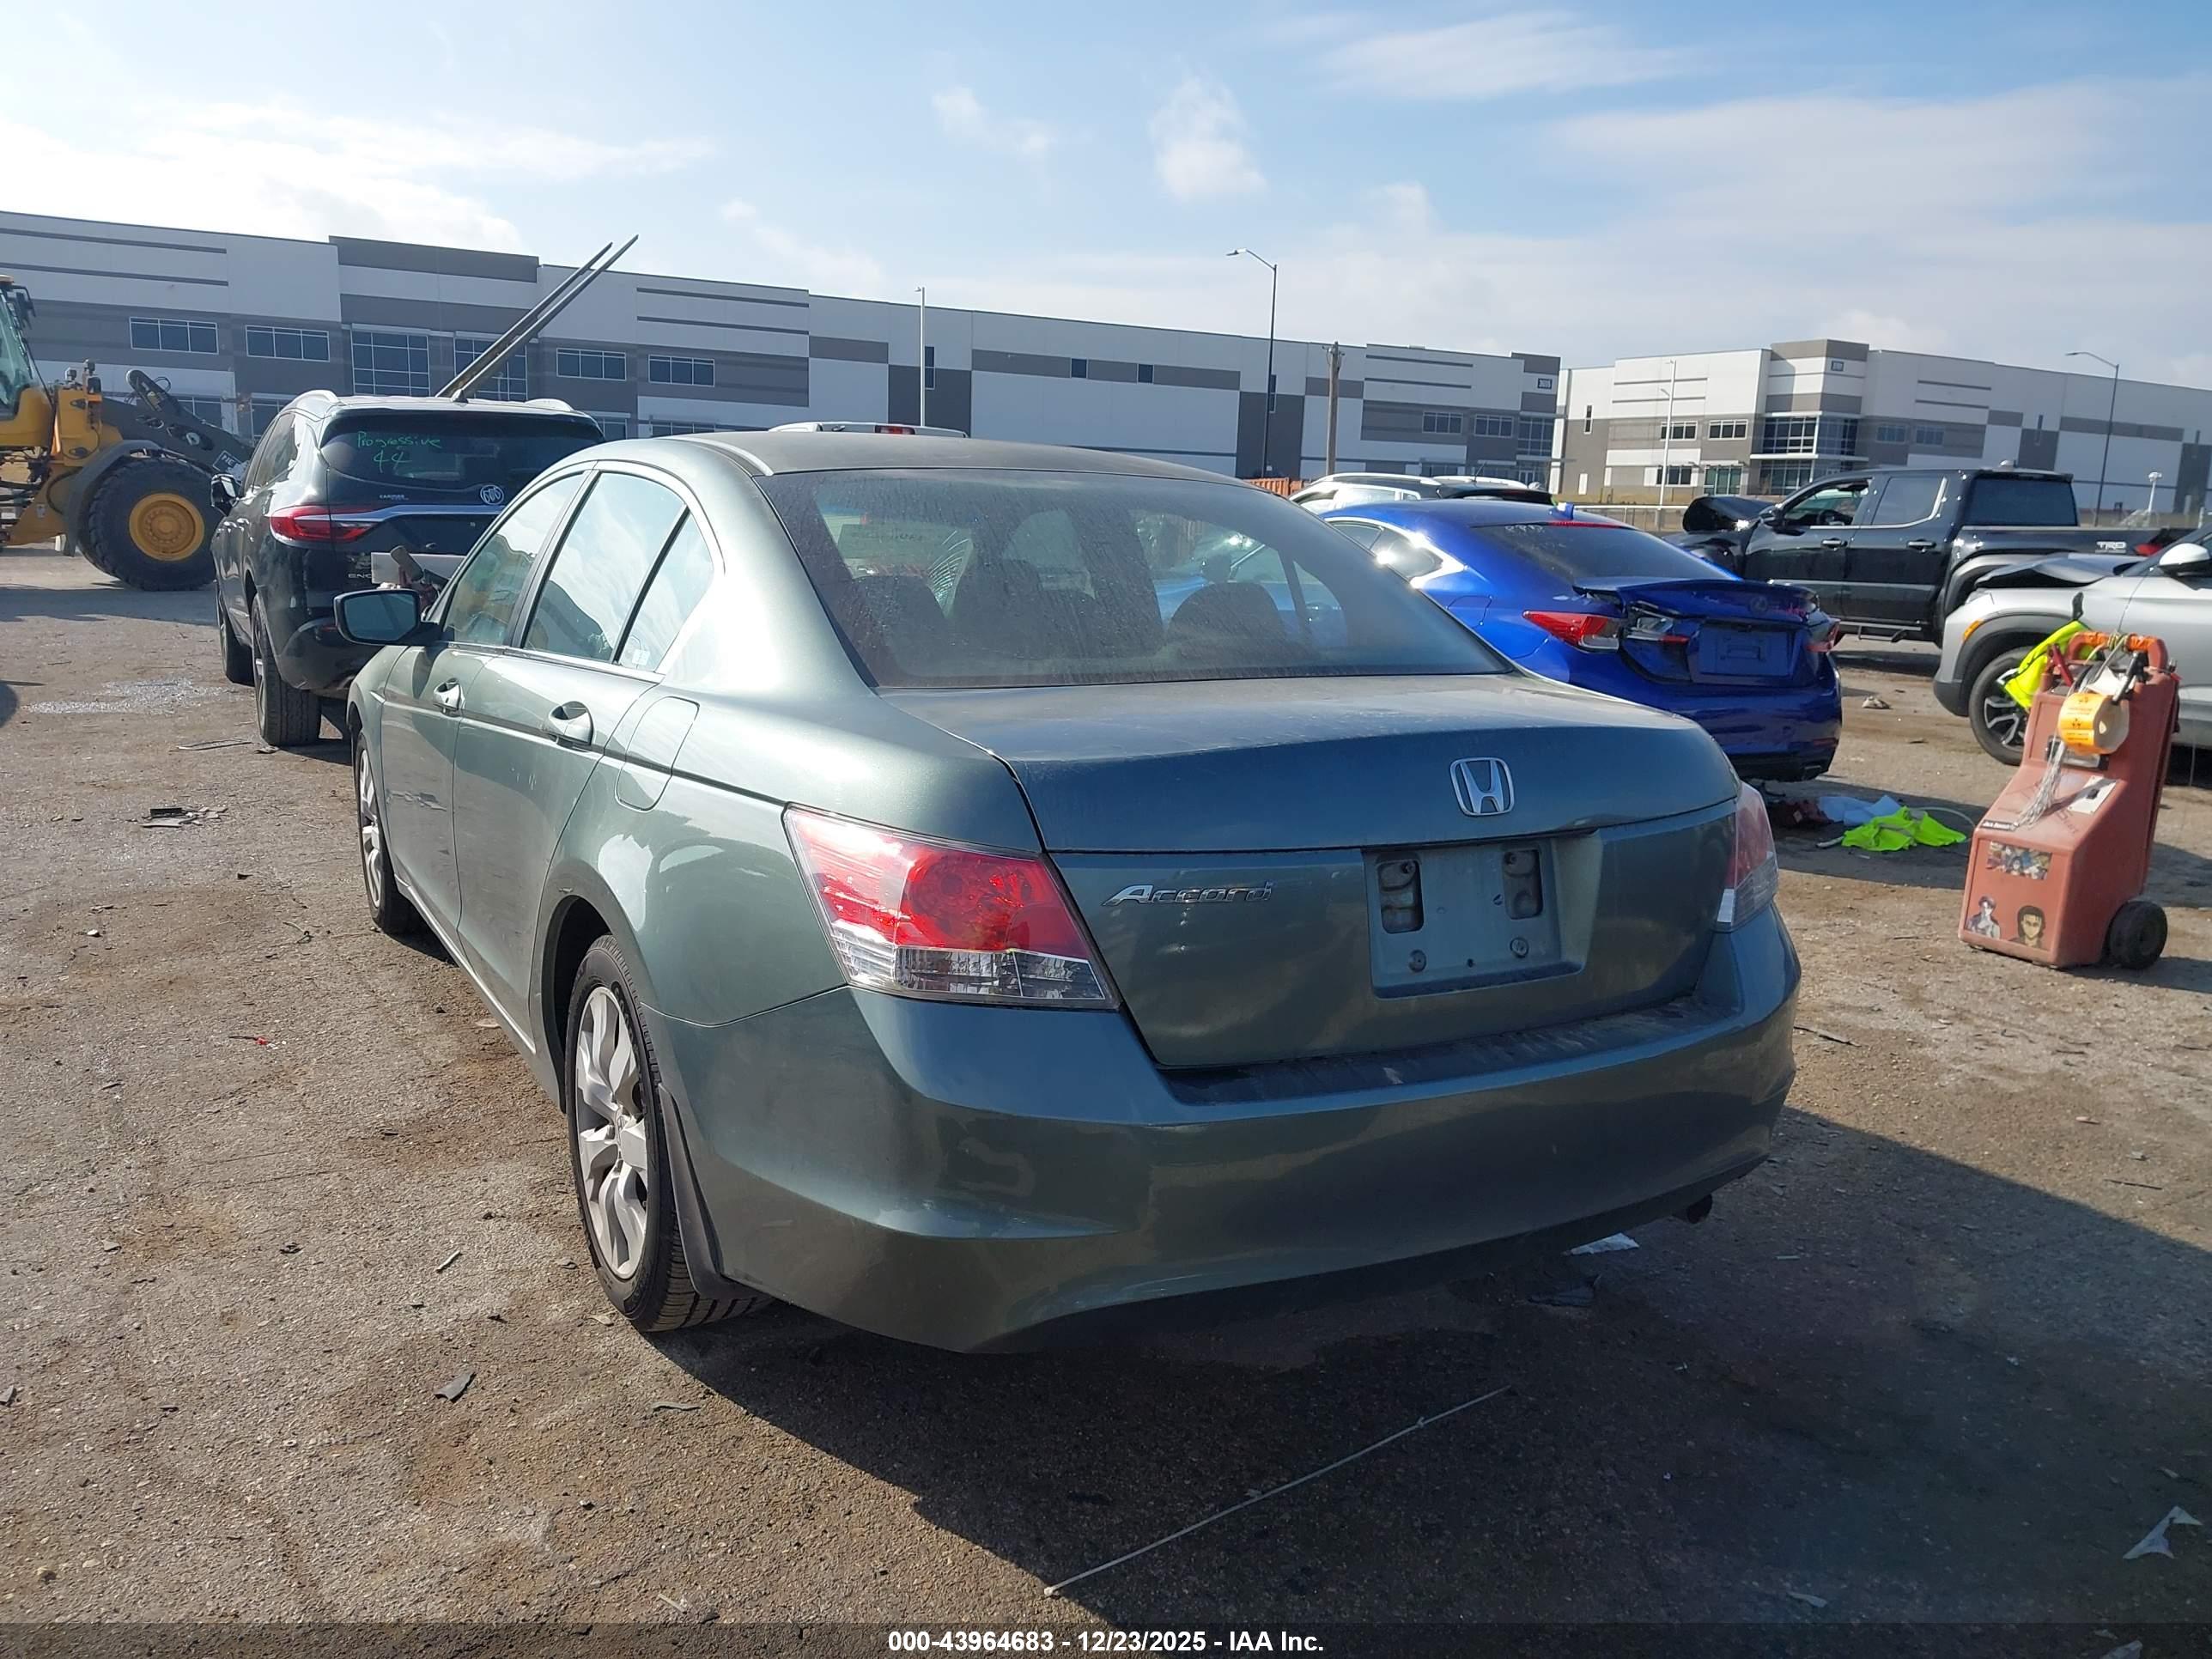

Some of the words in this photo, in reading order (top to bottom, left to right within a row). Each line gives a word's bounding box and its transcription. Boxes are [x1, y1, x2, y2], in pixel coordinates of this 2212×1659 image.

[357, 430, 442, 448] Progressive
[373, 449, 412, 473] 44
[2096, 541, 2127, 550] TRD
[1100, 880, 1276, 907] Accord
